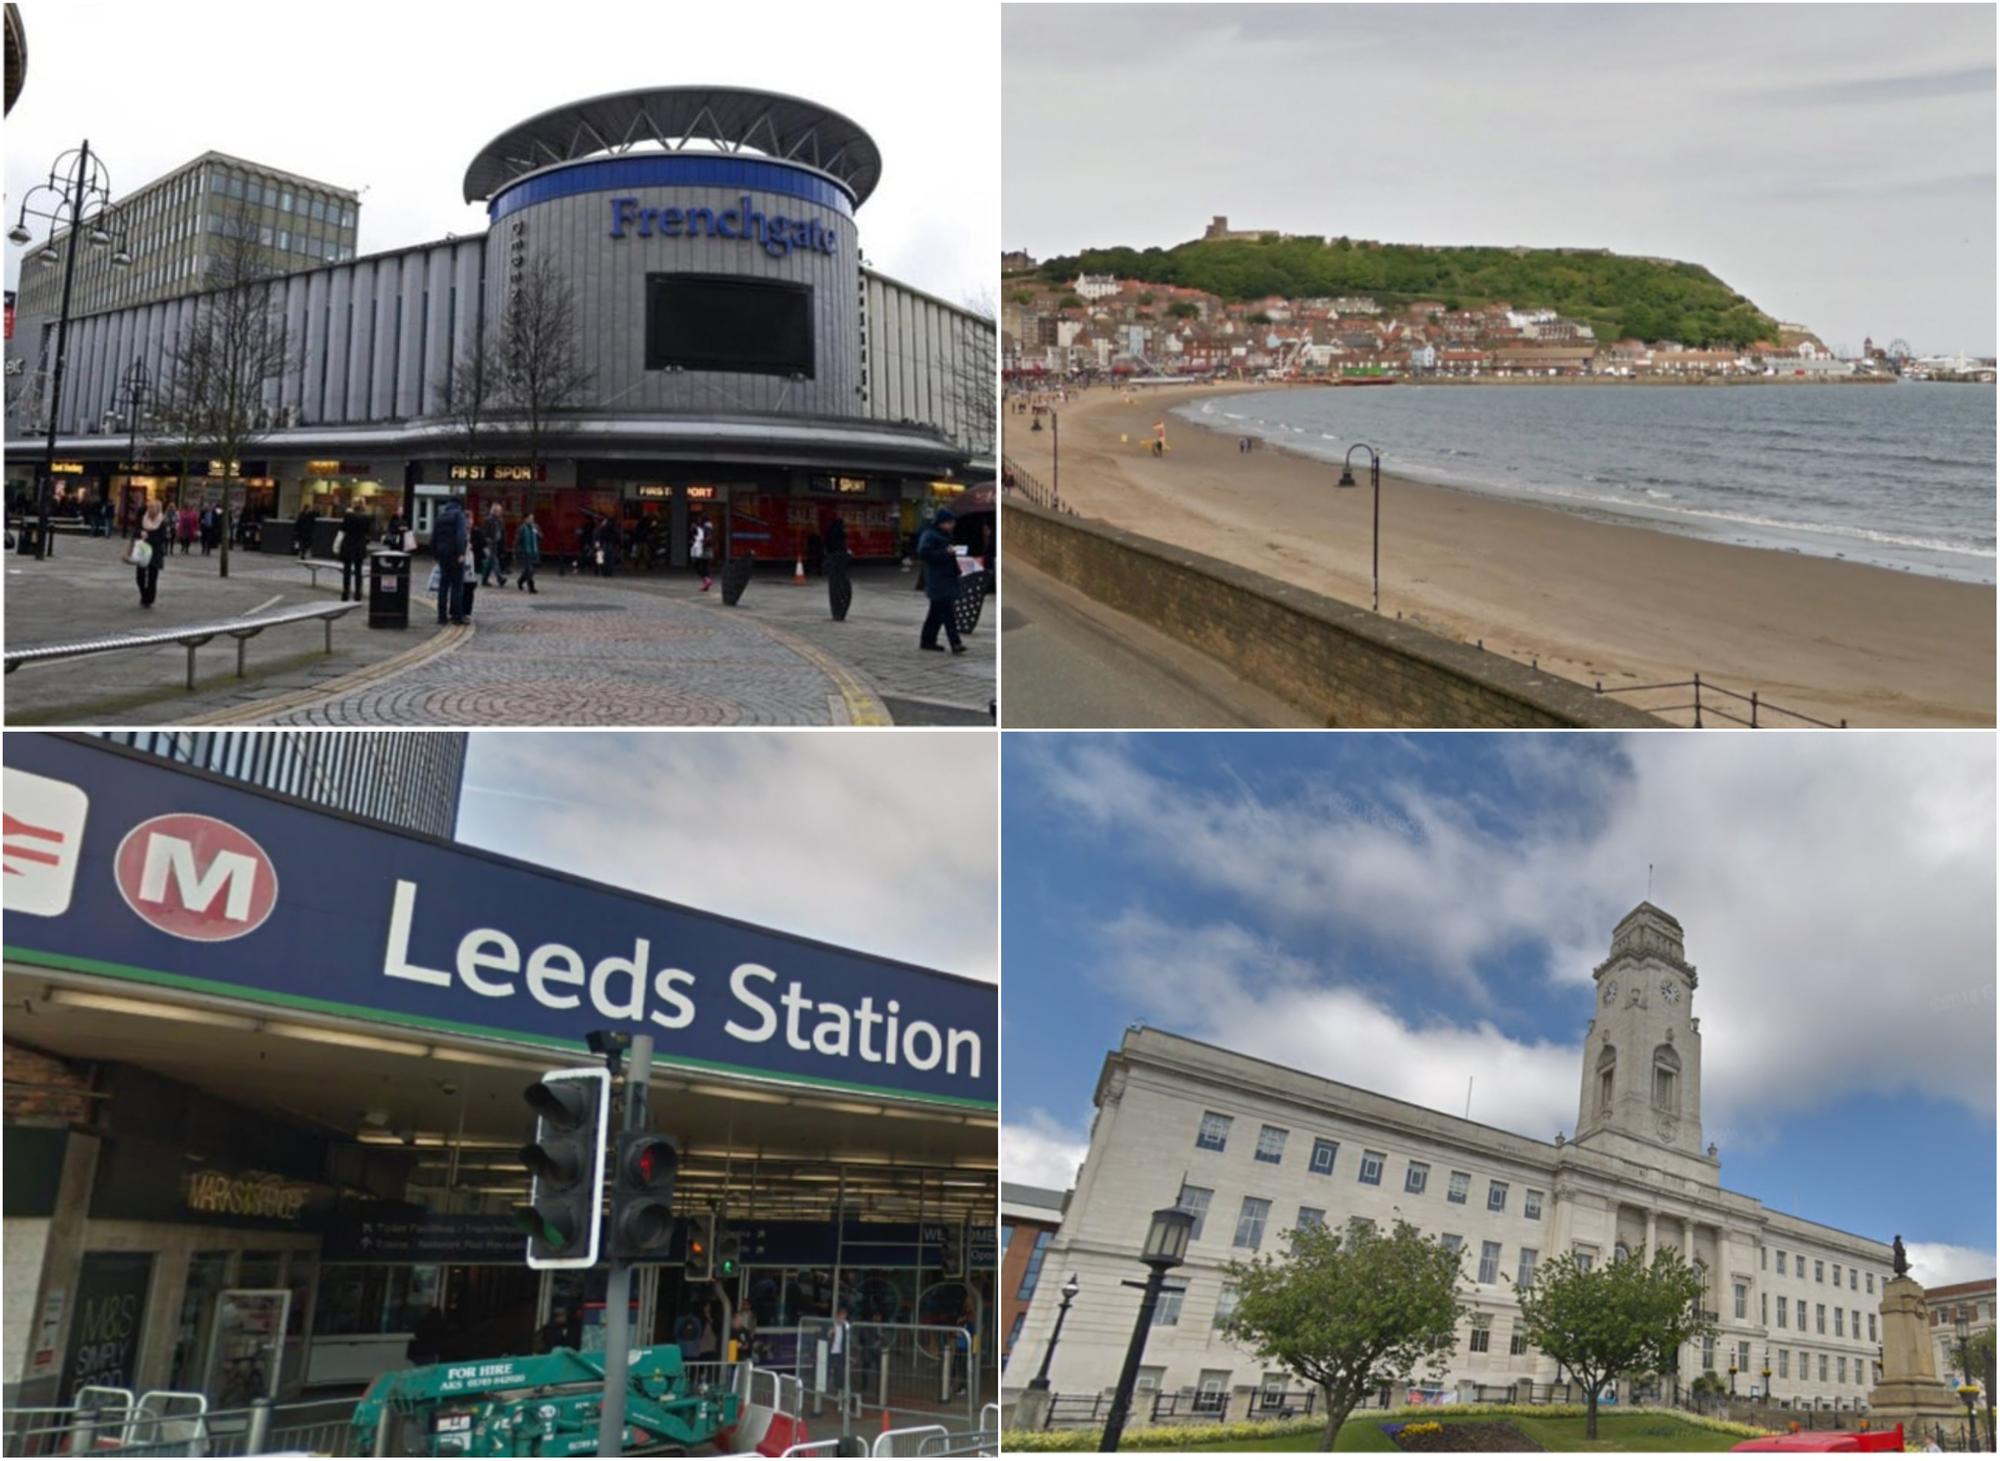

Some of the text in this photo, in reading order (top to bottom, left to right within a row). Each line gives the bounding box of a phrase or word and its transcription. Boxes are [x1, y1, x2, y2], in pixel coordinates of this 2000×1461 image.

[610, 196, 837, 258] Frenchgate
[138, 832, 257, 922] M
[383, 879, 981, 1078] Leeds Station
[448, 1363, 513, 1380] FOR HIRE
